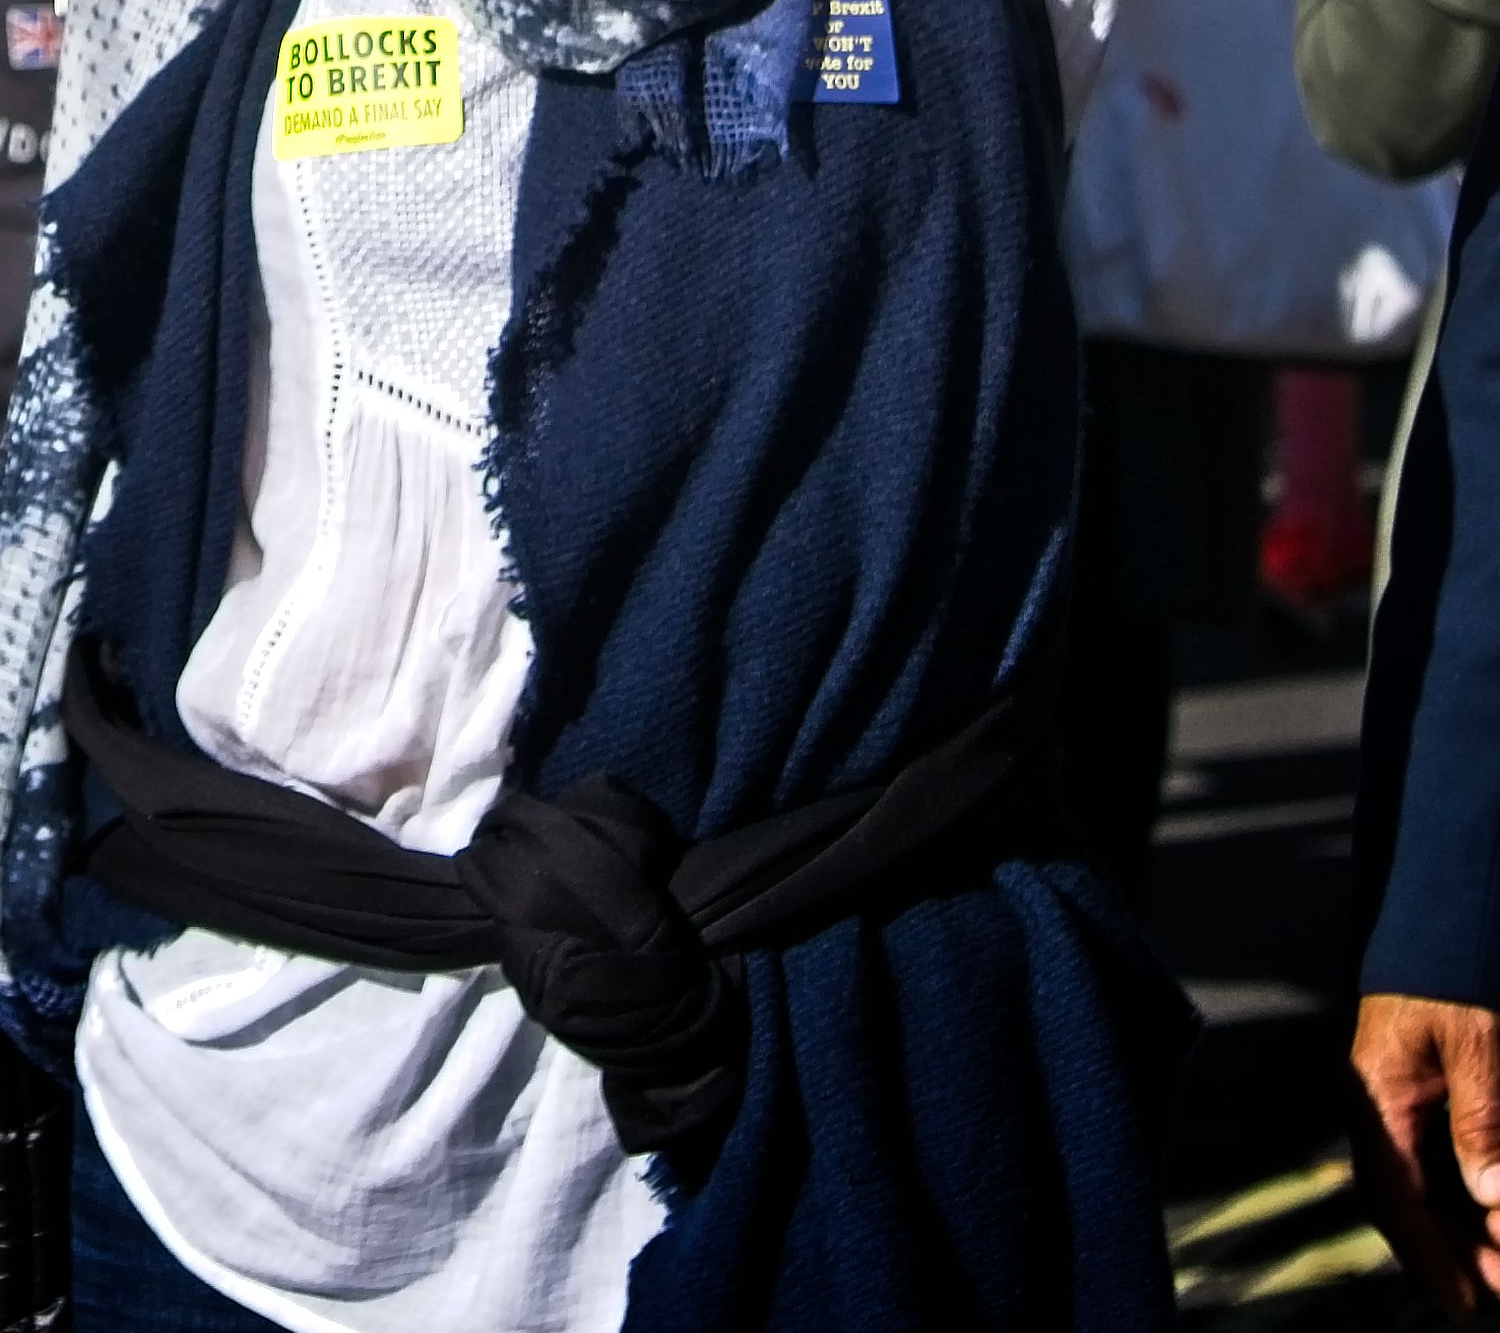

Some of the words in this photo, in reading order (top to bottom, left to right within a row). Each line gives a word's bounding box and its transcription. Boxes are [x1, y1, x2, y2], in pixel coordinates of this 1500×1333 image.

[829, 0, 885, 16] Brexit
[291, 29, 438, 70] BOLLOCKS
[847, 54, 874, 71] for
[286, 72, 314, 104] TO
[328, 60, 441, 96] BREXIT
[821, 73, 860, 90] YOU
[284, 107, 343, 136] DEMAND
[349, 106, 359, 127] A
[364, 99, 409, 125] FINAL
[413, 98, 442, 120] SAY
